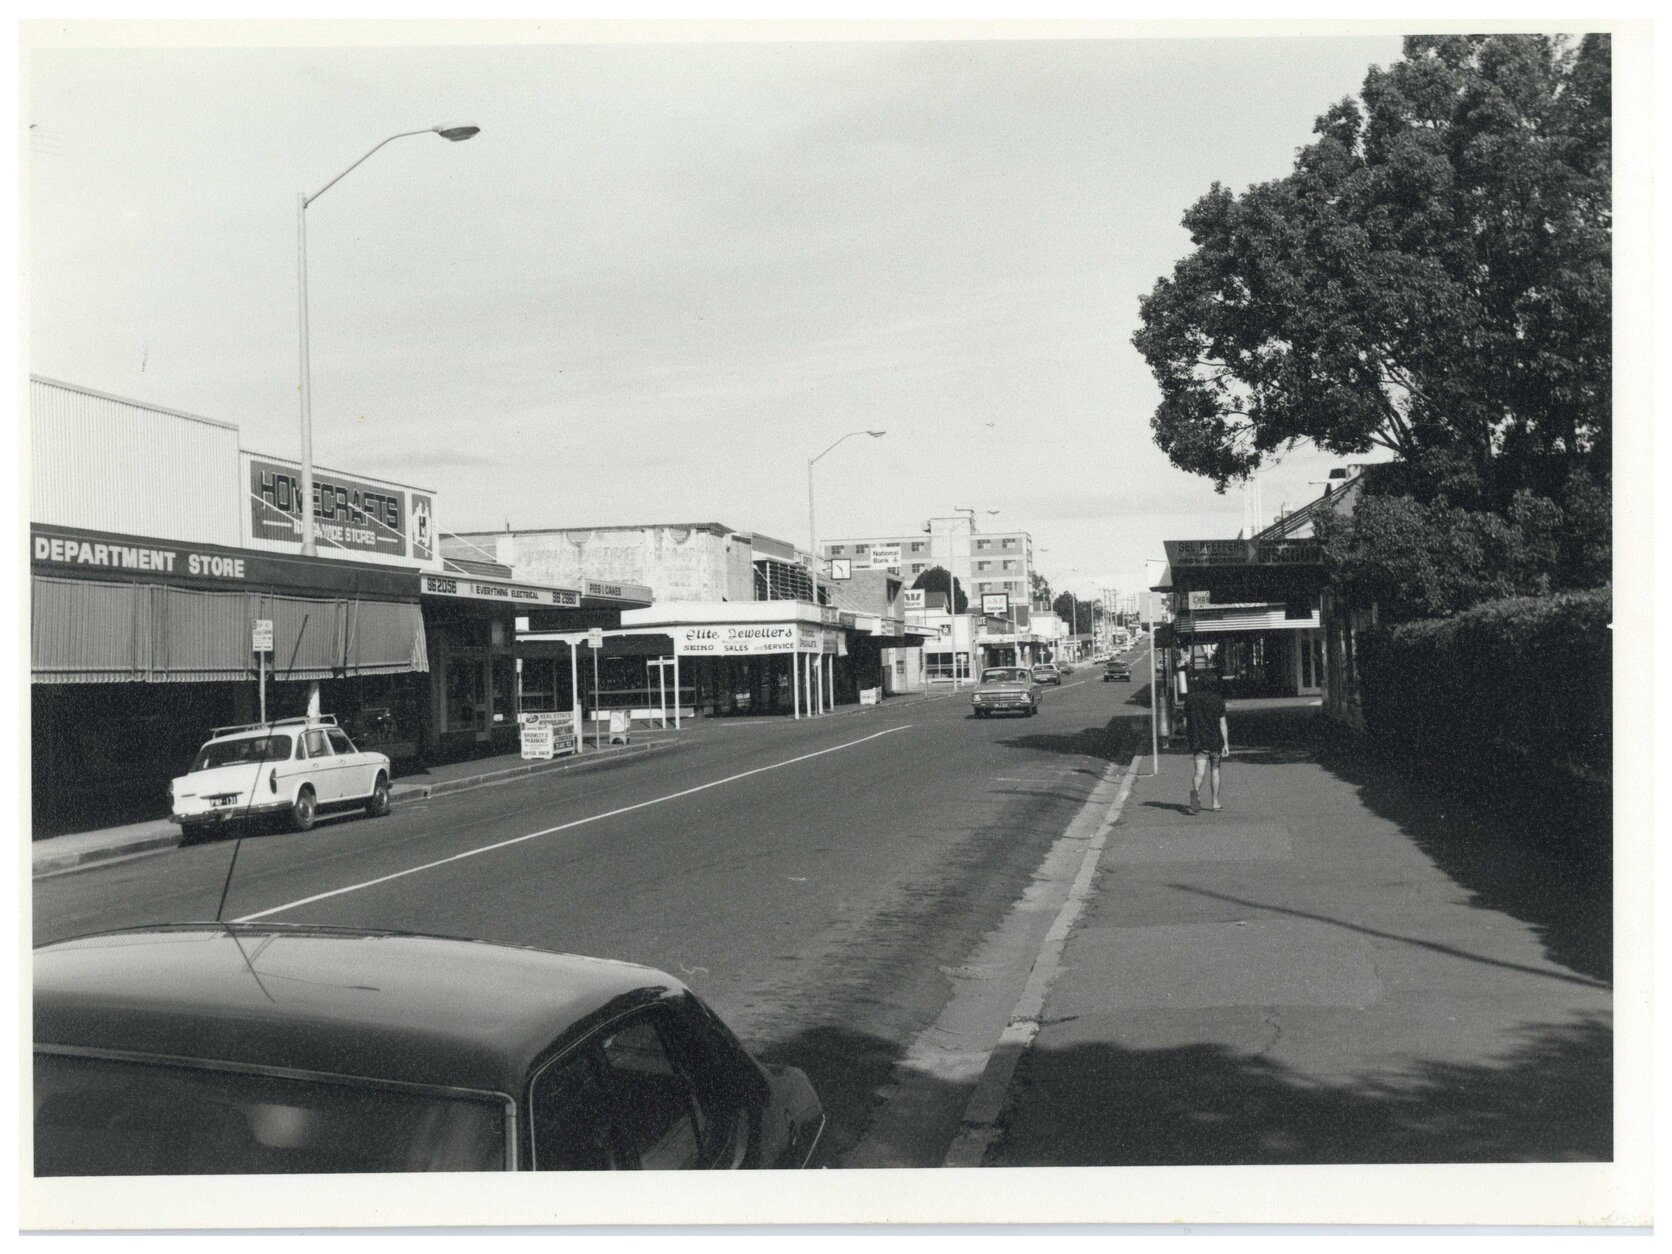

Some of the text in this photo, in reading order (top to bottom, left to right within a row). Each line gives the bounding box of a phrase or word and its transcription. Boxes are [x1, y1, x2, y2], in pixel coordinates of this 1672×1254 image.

[259, 471, 398, 530] HOMECRAFTS
[345, 528, 376, 545] STORES
[34, 536, 246, 578] DEPARTMENT STORE
[476, 585, 508, 597] EVERYTHING
[511, 589, 539, 600] ELECTRICAL
[589, 583, 601, 594] PIES
[605, 585, 622, 597] CAKES
[728, 627, 793, 640] Jewellers
[724, 644, 749, 652] SALES
[763, 642, 795, 651] SERVICE
